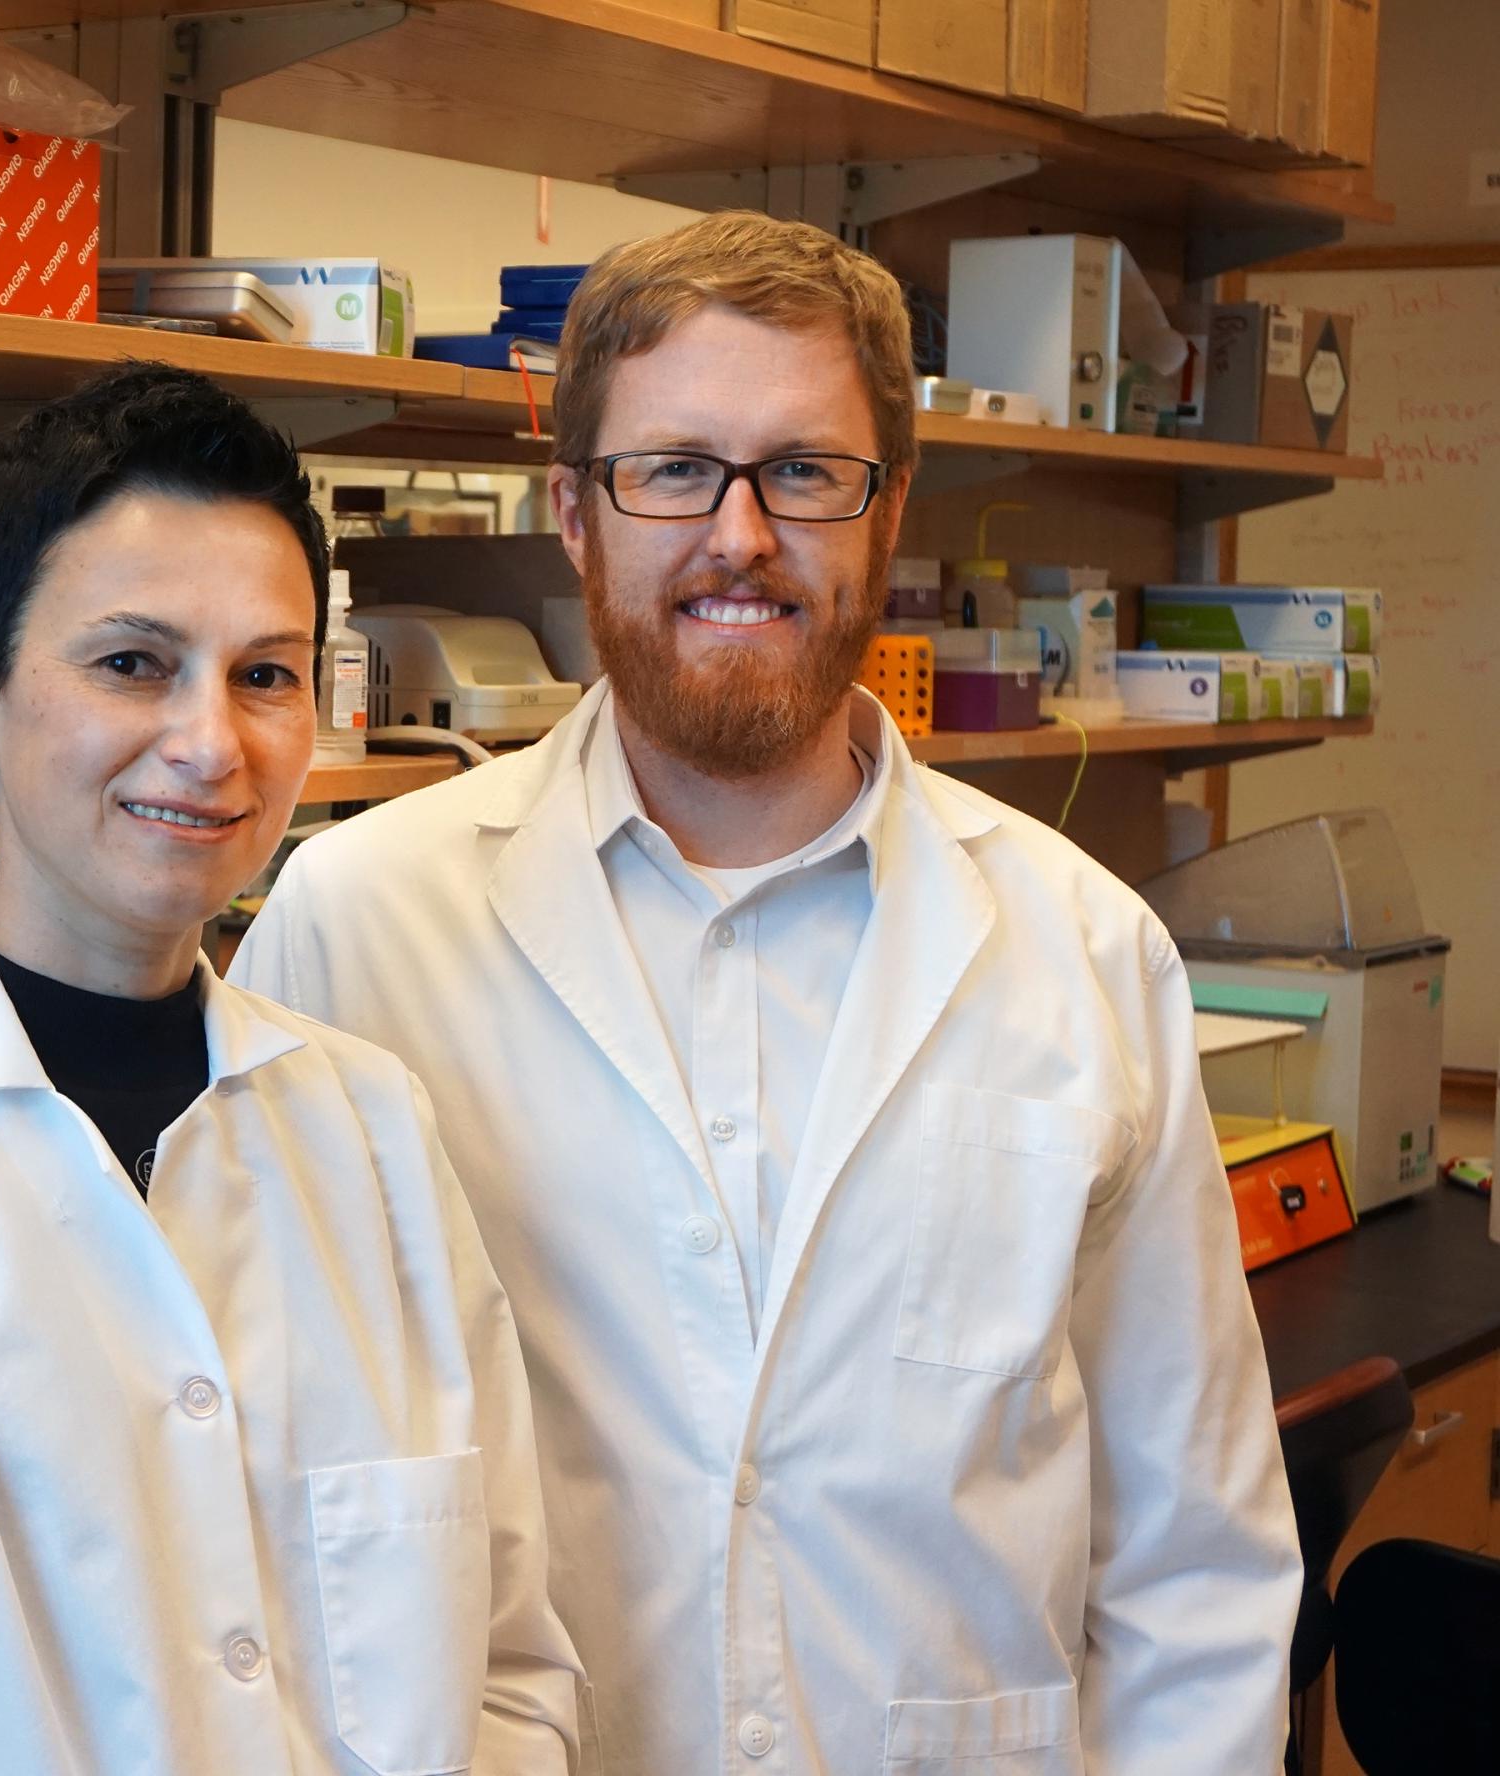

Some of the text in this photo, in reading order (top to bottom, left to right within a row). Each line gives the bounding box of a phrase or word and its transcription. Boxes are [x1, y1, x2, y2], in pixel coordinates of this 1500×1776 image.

[33, 136, 63, 178] QIAGEN
[16, 197, 46, 243] QIAGEN
[56, 178, 85, 222] QIAGEN
[0, 261, 31, 306] QIAGEN
[39, 241, 69, 286] QIAGEN
[341, 300, 357, 315] M
